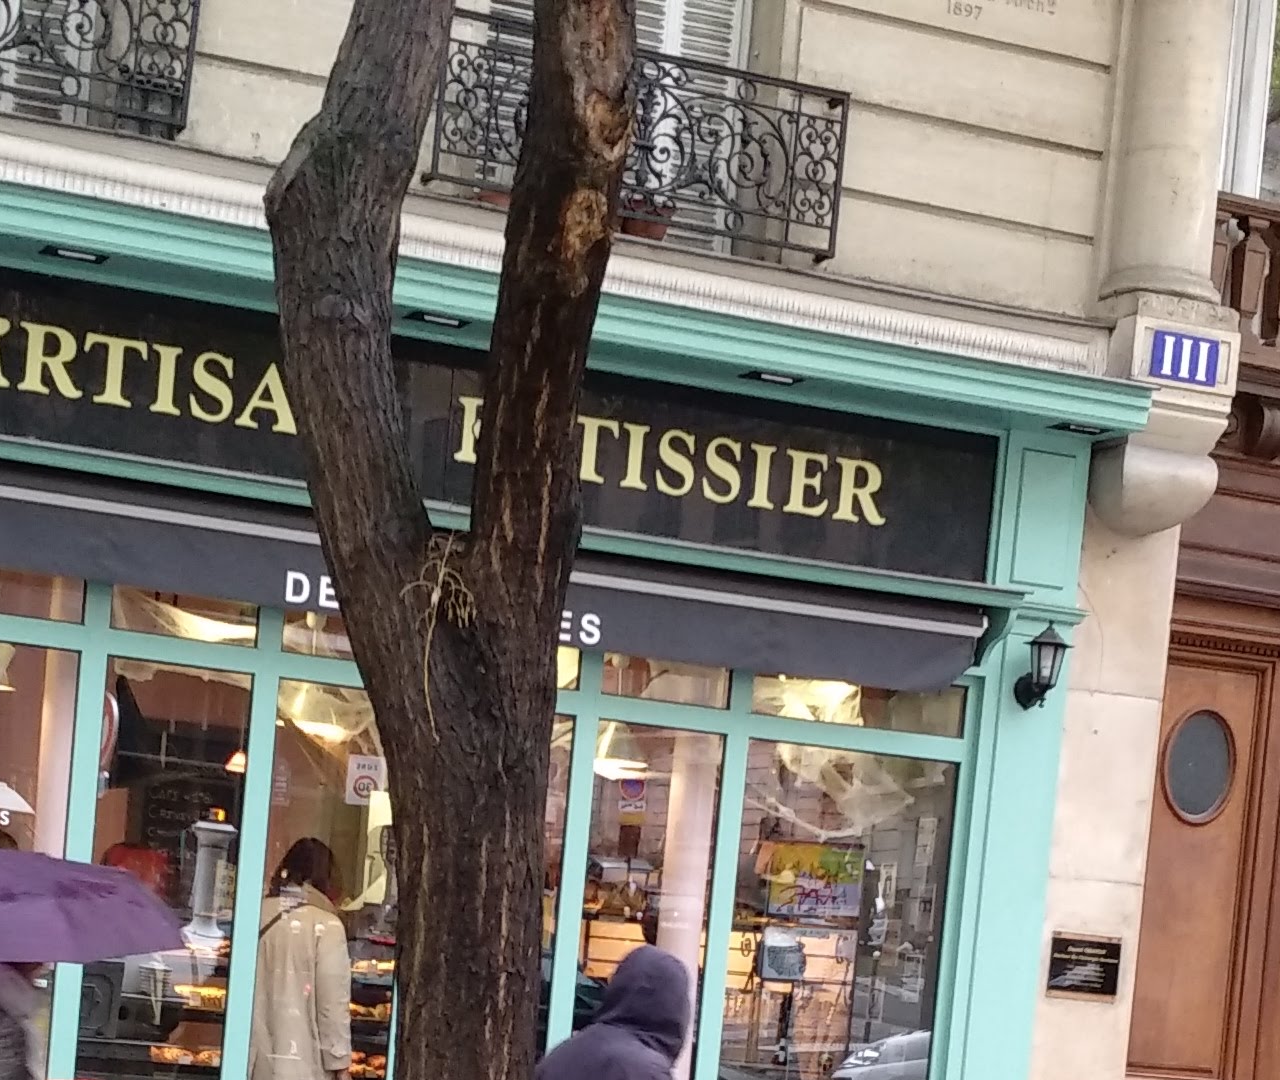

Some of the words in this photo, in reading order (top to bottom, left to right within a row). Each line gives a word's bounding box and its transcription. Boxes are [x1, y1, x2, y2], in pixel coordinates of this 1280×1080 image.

[947, 0, 983, 20] 1897
[453, 395, 887, 527] TISSIER
[284, 569, 340, 611] DE
